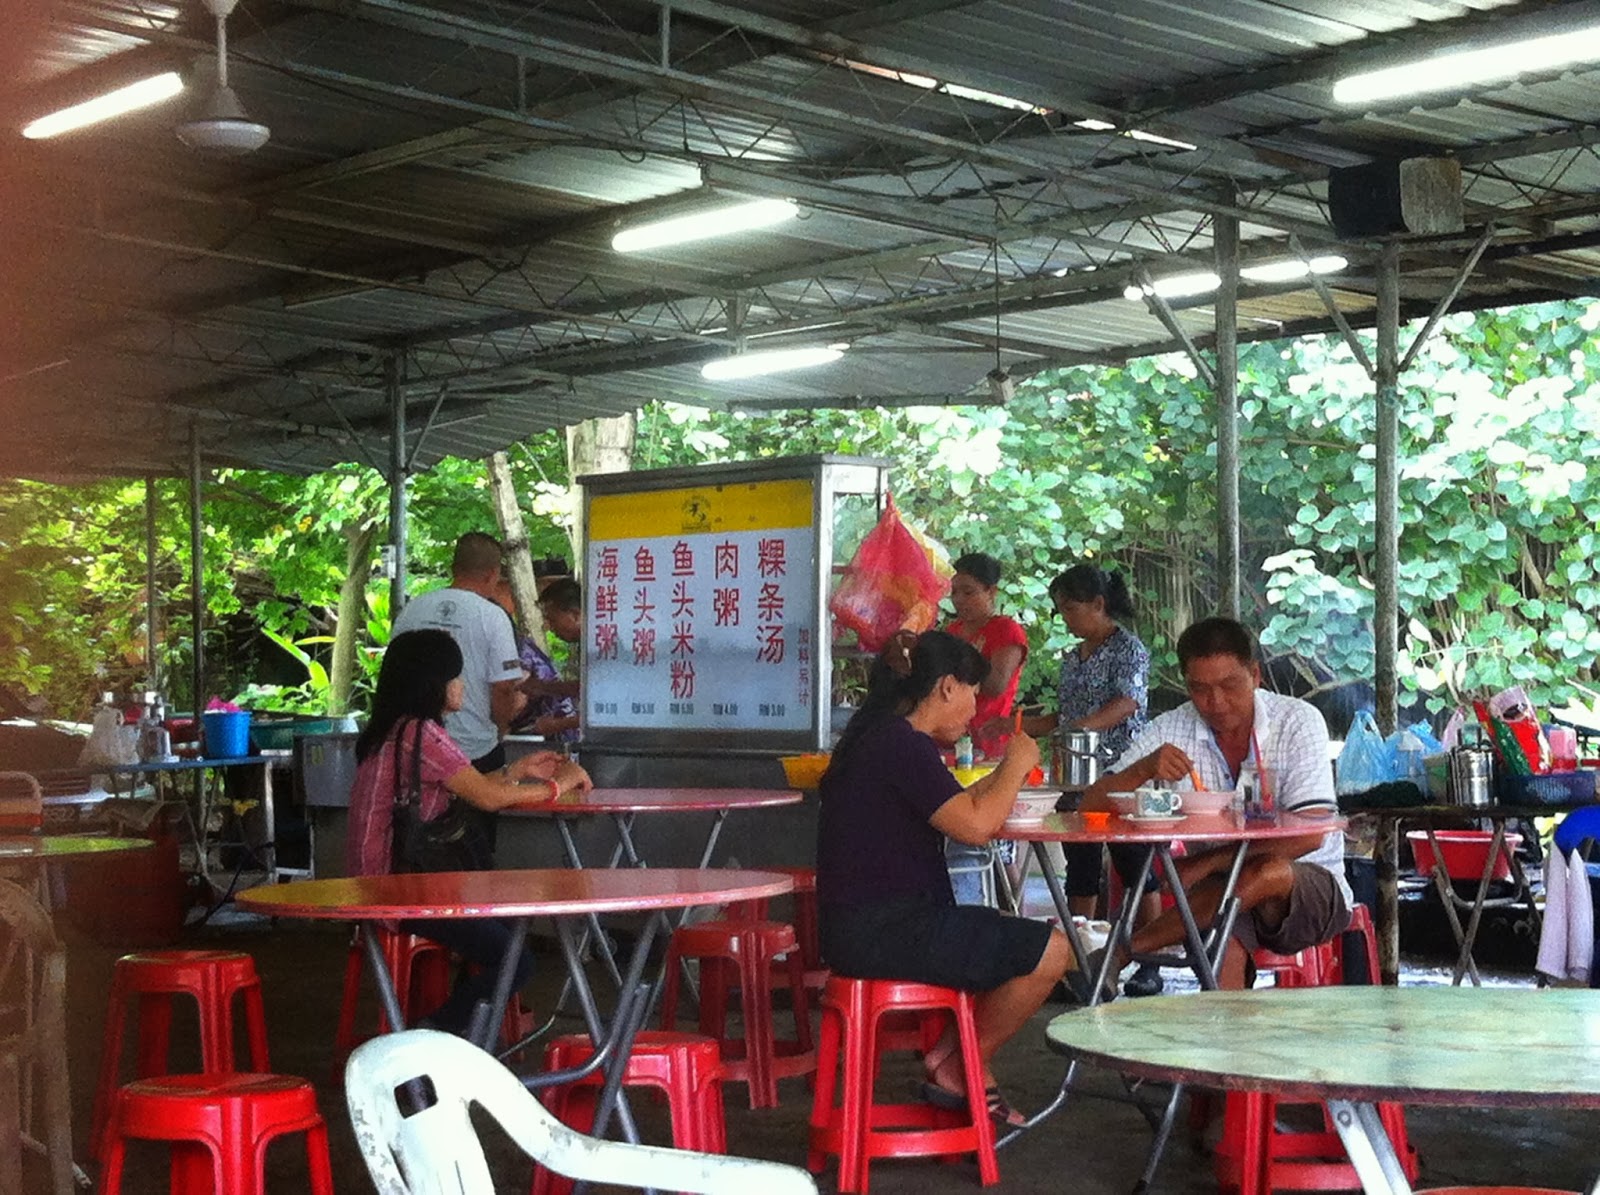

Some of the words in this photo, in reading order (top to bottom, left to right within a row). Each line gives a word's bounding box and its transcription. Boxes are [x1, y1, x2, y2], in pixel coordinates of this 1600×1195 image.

[595, 546, 618, 660] 海鲜粥
[633, 545, 656, 666] 鱼头粥
[671, 540, 695, 699] 鱼头米粉
[713, 540, 739, 626] 肉粥
[757, 538, 786, 664] 粿条汤
